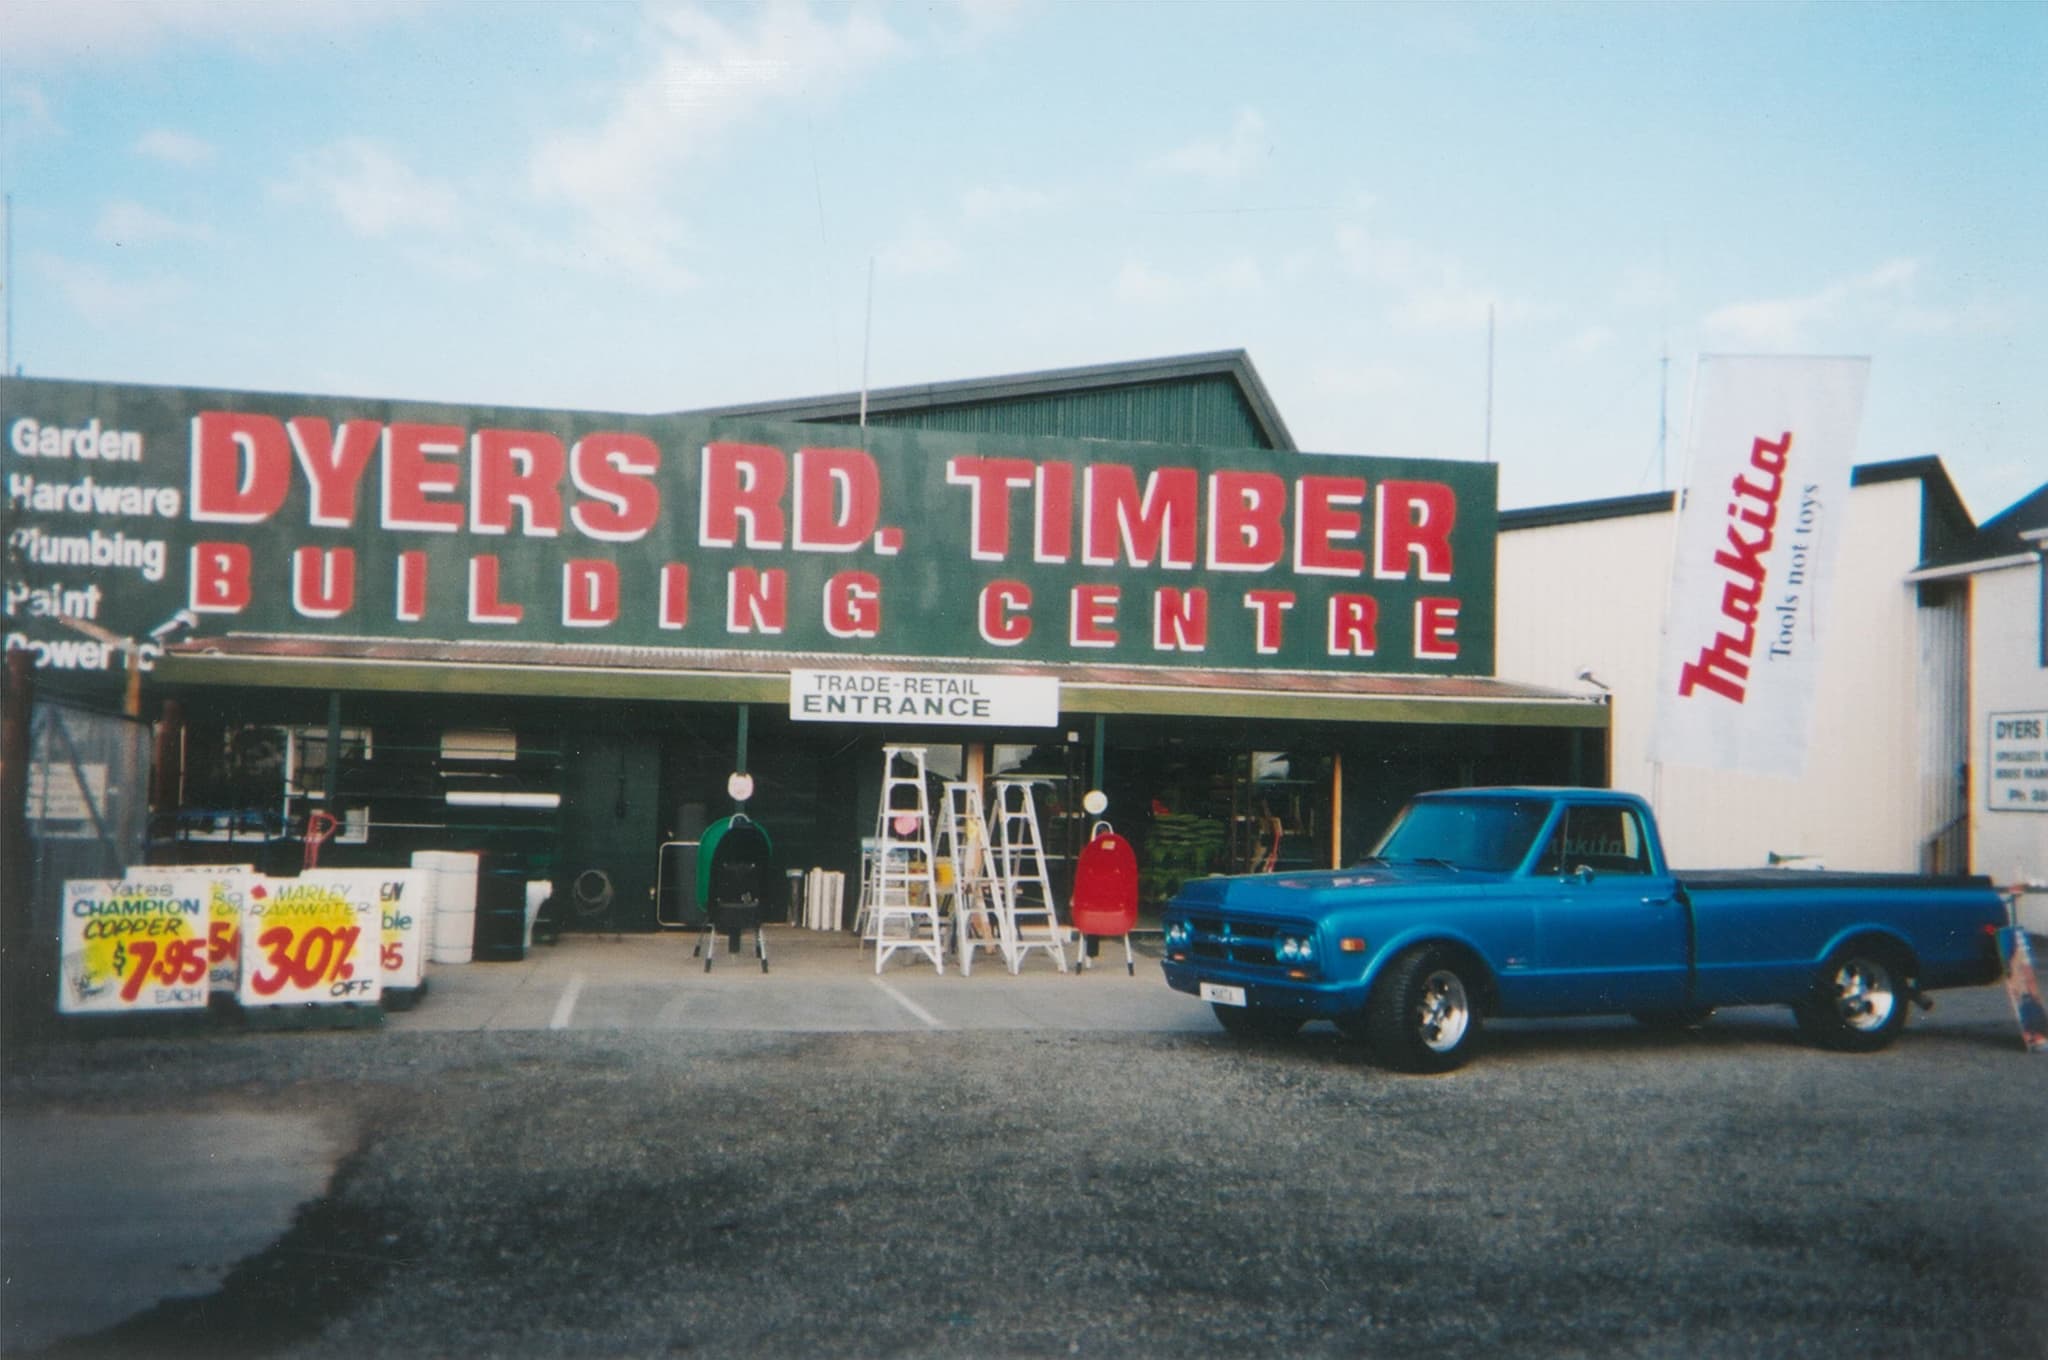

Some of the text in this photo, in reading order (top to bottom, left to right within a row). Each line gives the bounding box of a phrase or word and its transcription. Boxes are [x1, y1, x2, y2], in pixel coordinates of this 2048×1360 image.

[10, 417, 143, 462] Garden
[8, 472, 181, 518] Hardware
[189, 409, 1457, 582] DYERS RD. TIMBER
[1678, 431, 1792, 704] makita
[1769, 483, 1823, 663] Tools not toys
[190, 541, 1462, 661] BUILDING CENTRE
[813, 673, 980, 696] TRADE-RETAIL
[803, 693, 991, 718] ENTRANCE
[1995, 719, 2041, 740] DYERS
[107, 880, 174, 898] Yates
[274, 883, 353, 902] MARLEY
[73, 898, 200, 918] CHAMPION
[248, 902, 372, 918] RAINWATER
[84, 918, 182, 941] COPPER
[252, 926, 361, 996] 30%
[155, 989, 202, 1003] EACH
[330, 978, 374, 997] OFF
